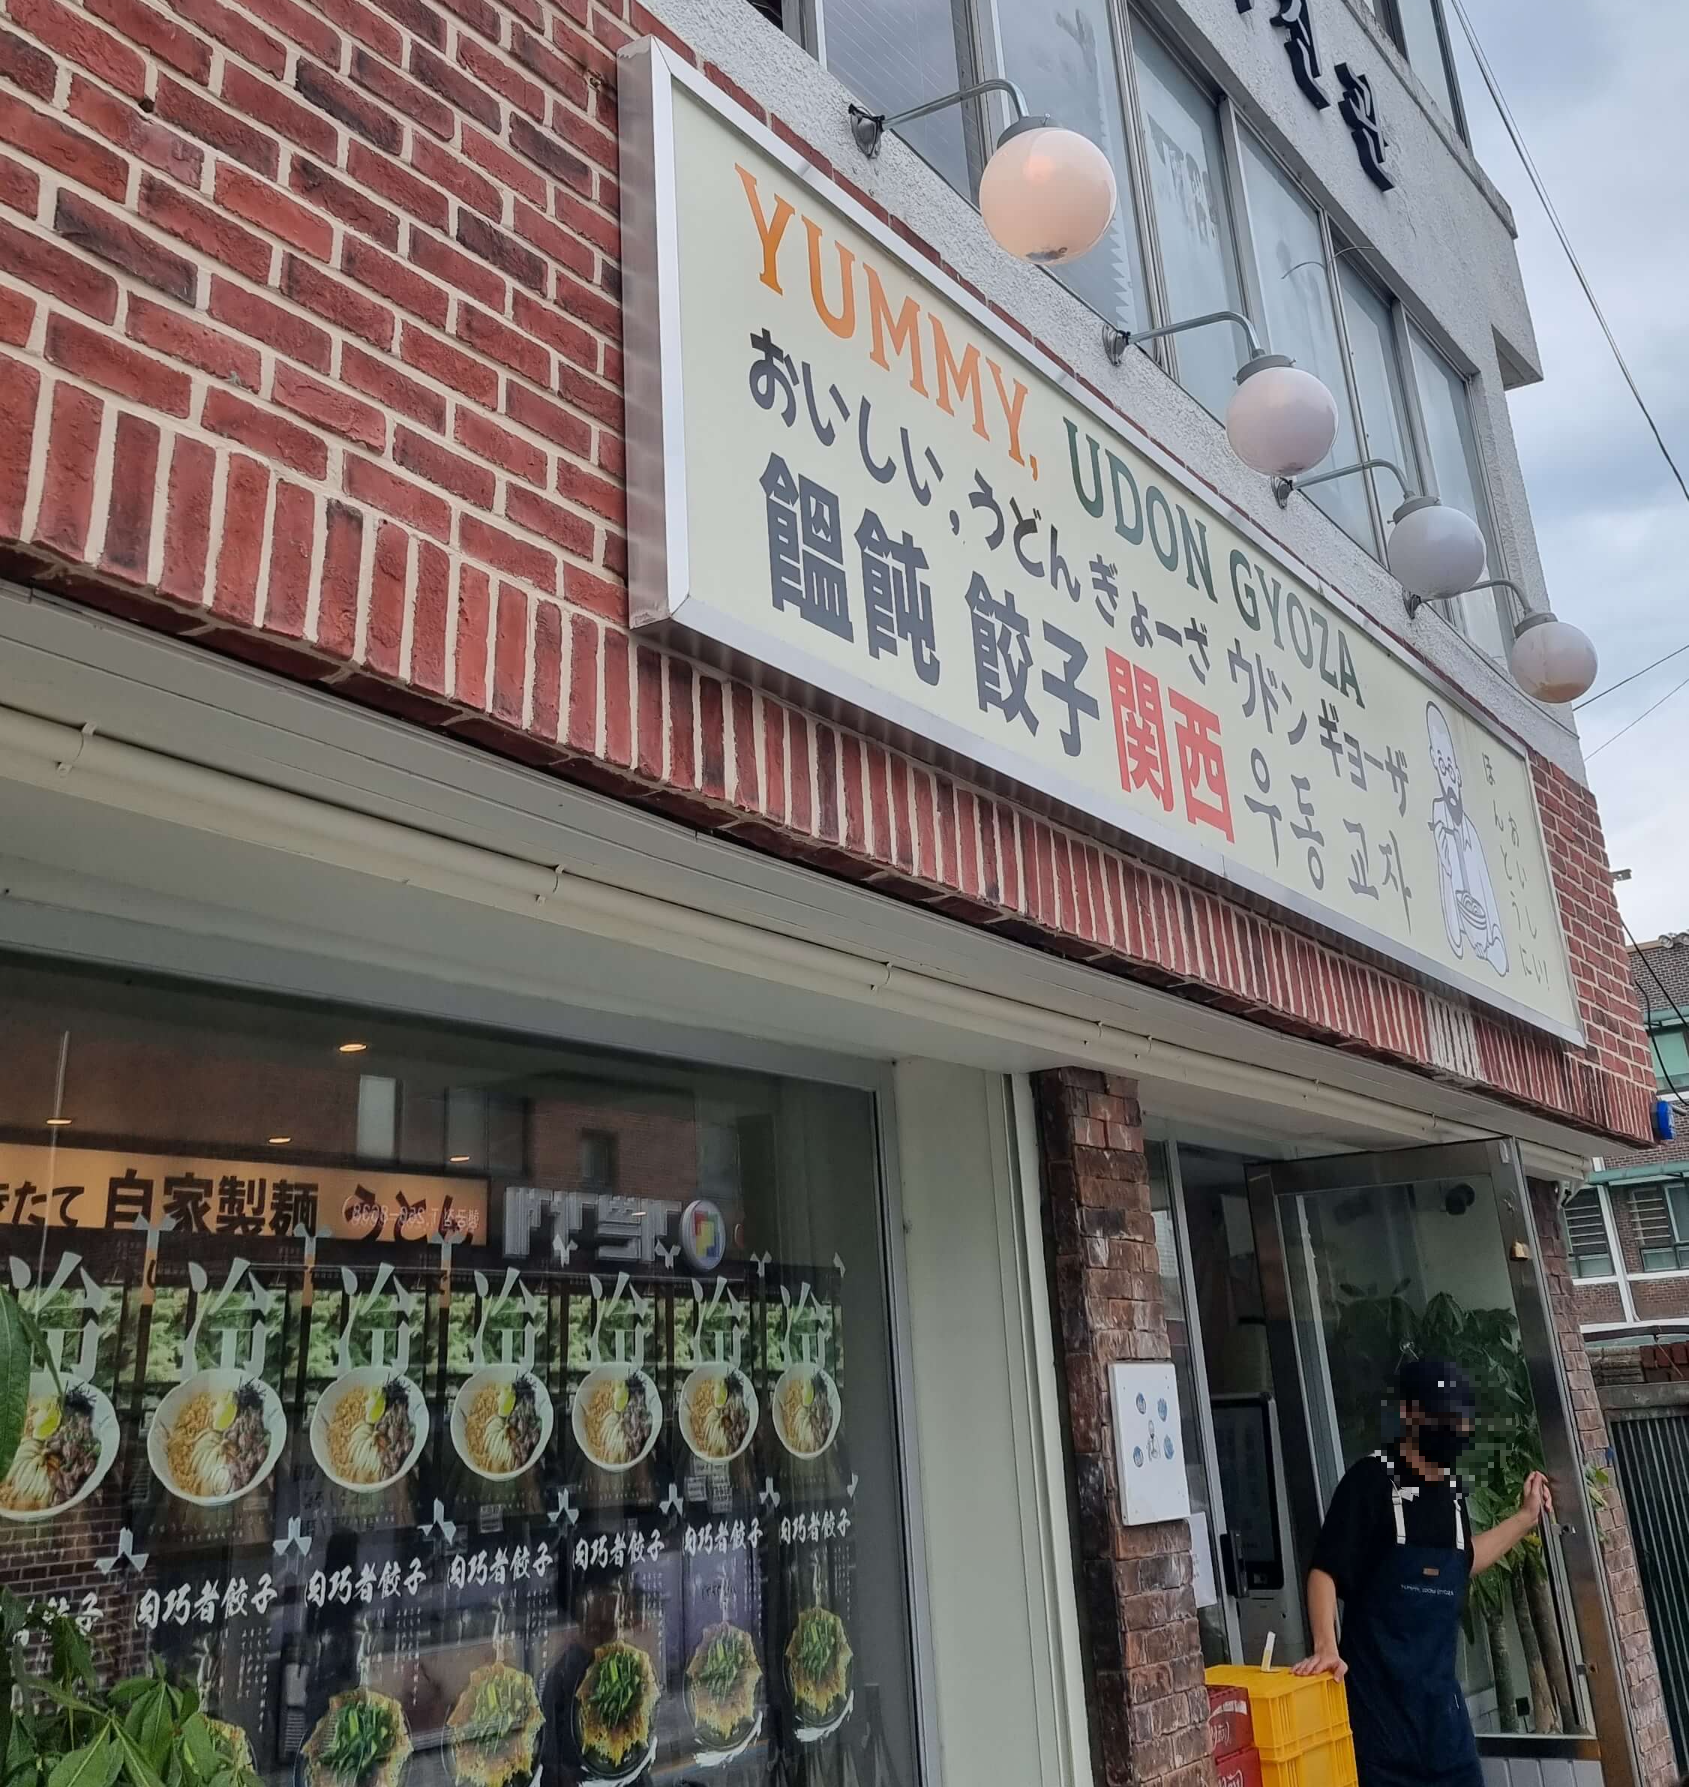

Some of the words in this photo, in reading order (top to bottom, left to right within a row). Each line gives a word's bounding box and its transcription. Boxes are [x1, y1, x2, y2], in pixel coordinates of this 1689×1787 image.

[734, 163, 1039, 482] YUMMY,
[1062, 415, 1219, 606] UDON
[1230, 547, 1366, 711] GYOZA
[1104, 646, 1237, 845] 関西
[1244, 747, 1326, 893] 우동
[1347, 818, 1413, 935] 교자
